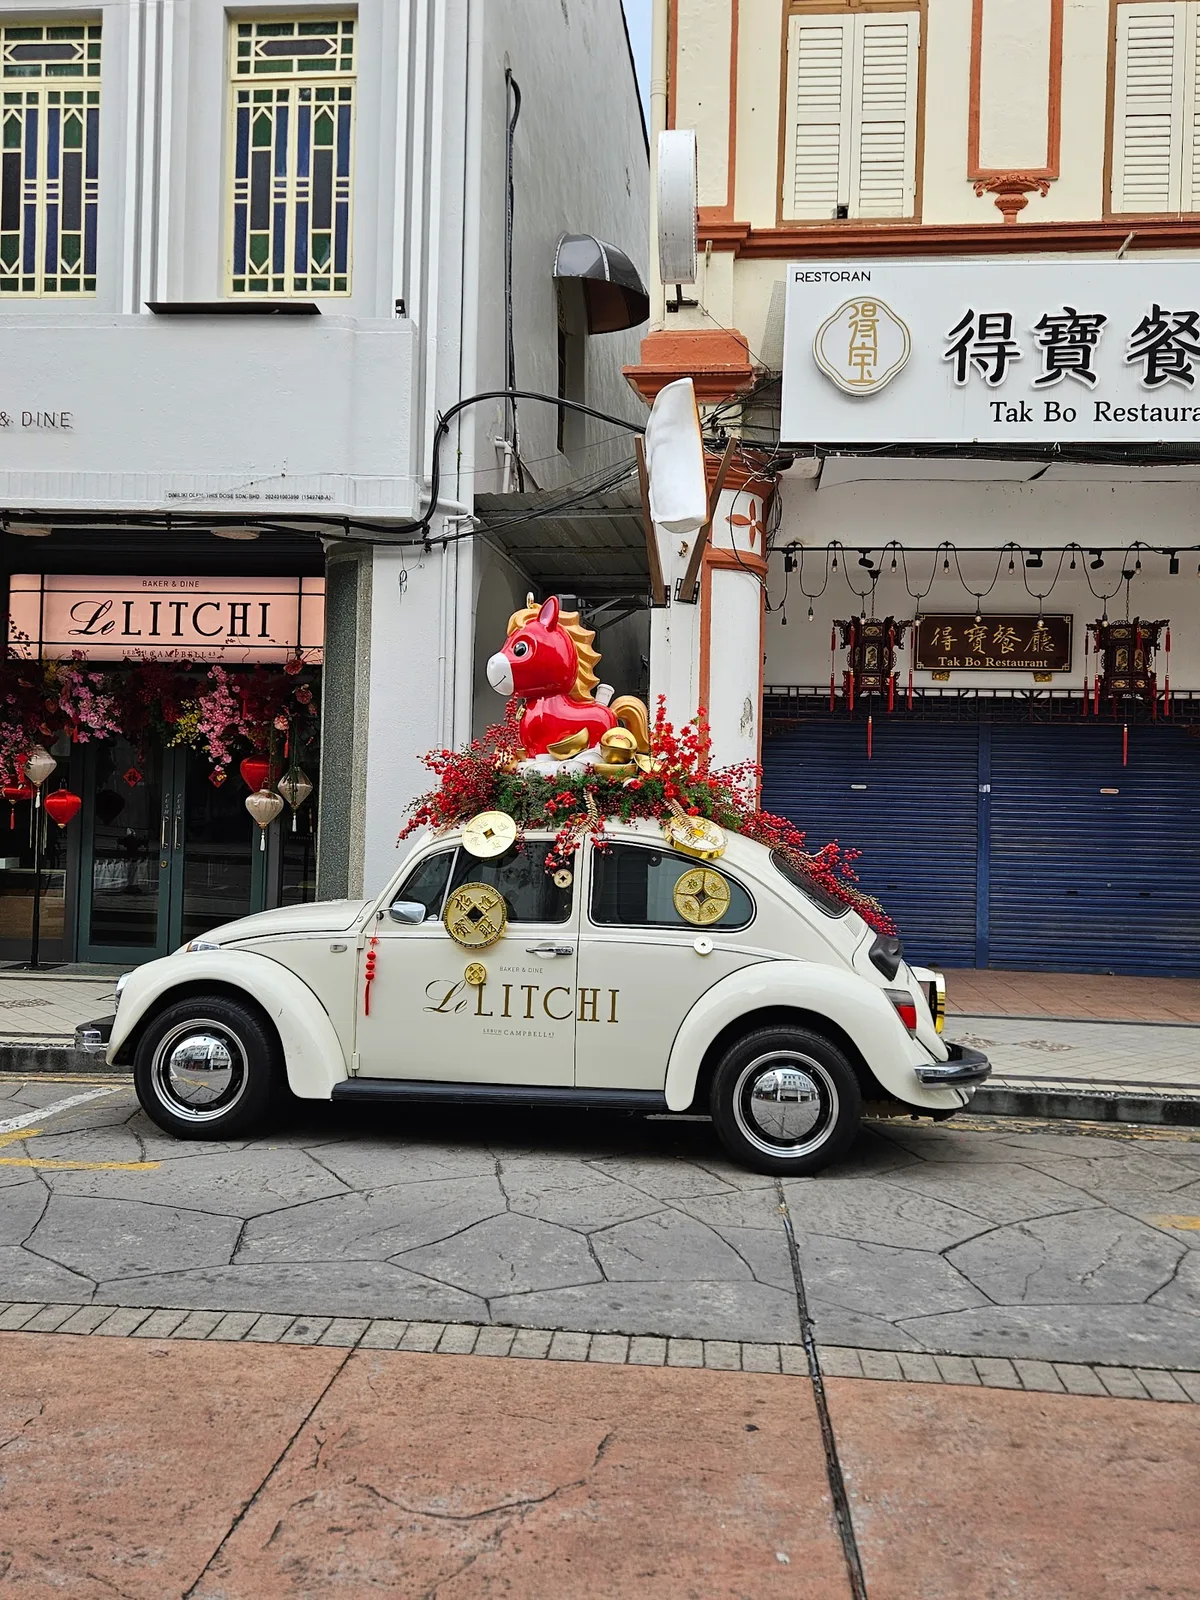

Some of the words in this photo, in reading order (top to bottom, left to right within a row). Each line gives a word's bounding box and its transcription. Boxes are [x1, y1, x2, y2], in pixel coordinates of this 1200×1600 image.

[795, 271, 871, 282] RESTORAN
[945, 303, 1200, 385] 得寶餐
[21, 411, 72, 429] DINE
[990, 401, 1033, 423] Tak
[1043, 402, 1077, 422] Bo
[180, 580, 200, 588] DINE
[68, 600, 116, 636] Le
[121, 601, 271, 637] LITCHI
[930, 624, 1055, 655] 得寶餐廳
[938, 656, 960, 667] Tak
[965, 656, 981, 667] Bo
[985, 657, 1049, 668] Restaurant
[423, 979, 468, 1014] Le
[474, 983, 620, 1023] LITCHI
[503, 1029, 548, 1038] CAMPBELL
